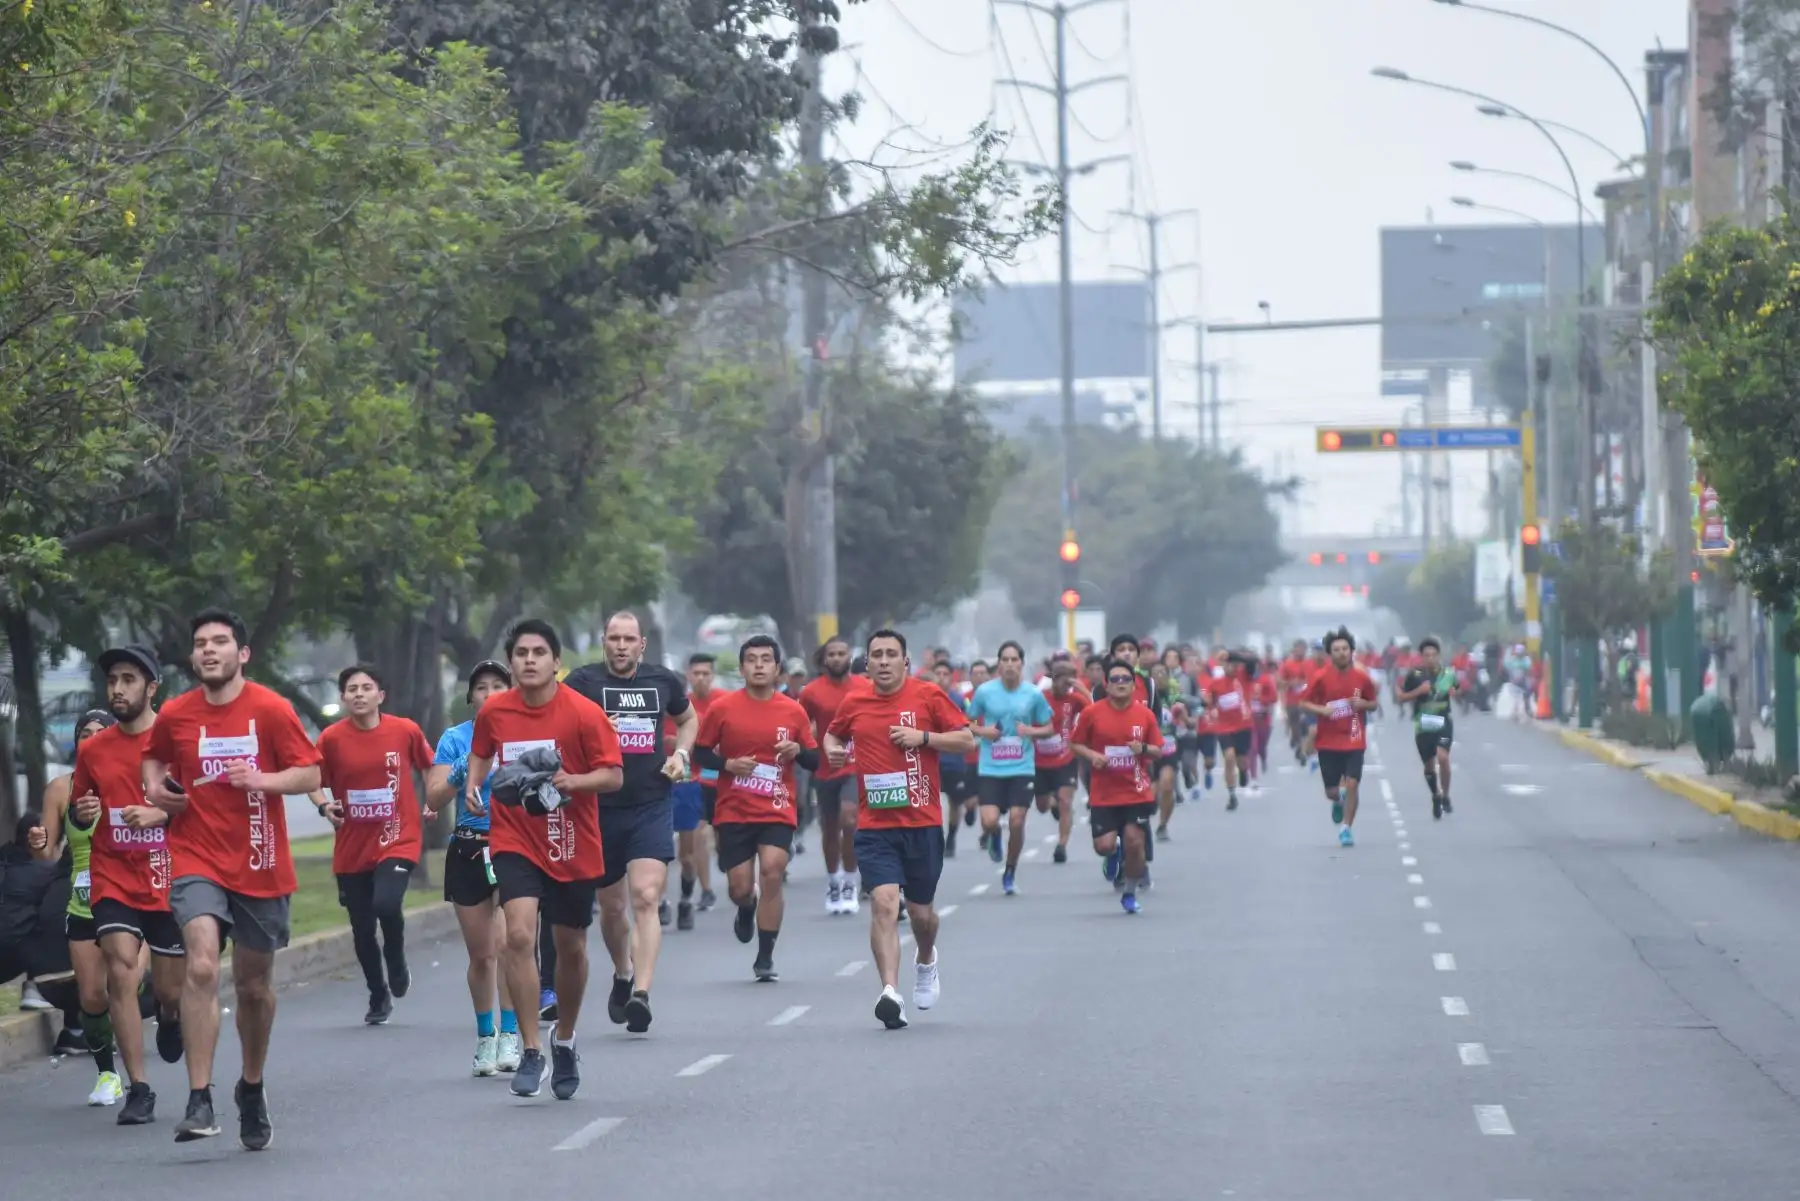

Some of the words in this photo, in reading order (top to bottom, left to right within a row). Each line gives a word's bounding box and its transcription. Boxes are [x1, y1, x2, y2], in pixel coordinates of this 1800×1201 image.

[900, 711, 911, 726] 21
[617, 734, 655, 748] 0404
[202, 756, 257, 776] 006
[867, 788, 908, 804] 00748
[350, 804, 393, 818] 00143
[112, 827, 165, 843] 00488
[567, 820, 575, 860] TRUJILLO
